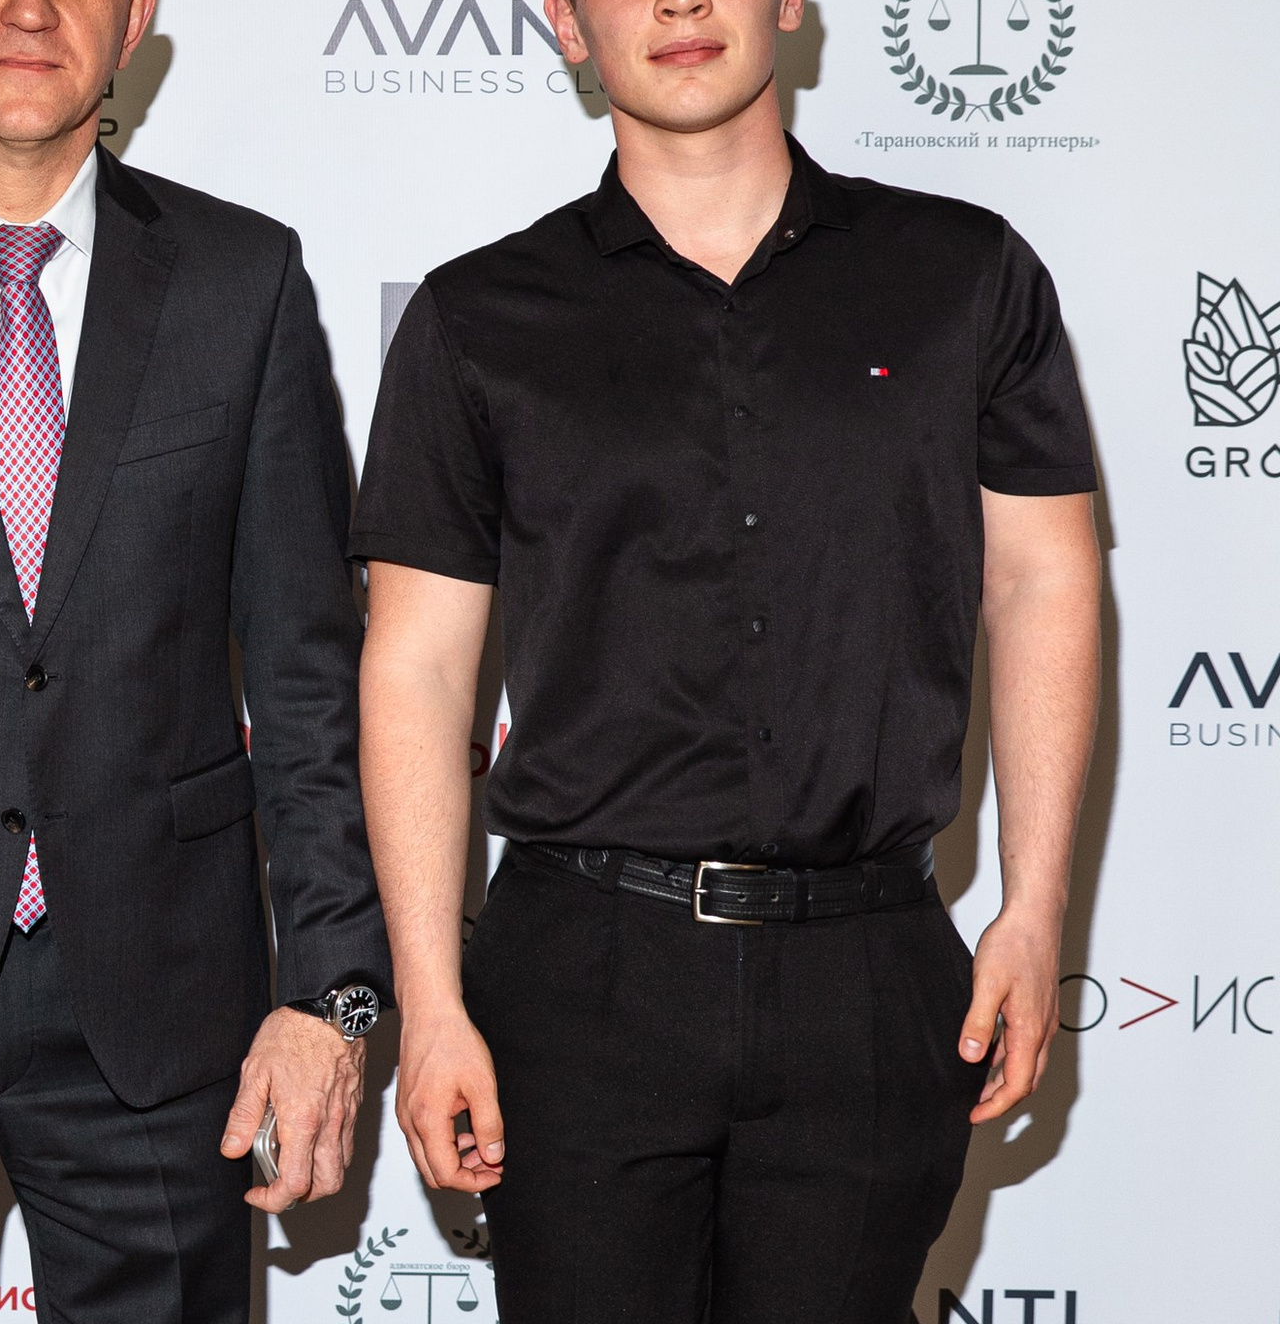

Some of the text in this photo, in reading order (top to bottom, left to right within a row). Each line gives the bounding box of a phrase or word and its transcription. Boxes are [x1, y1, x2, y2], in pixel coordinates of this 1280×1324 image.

[325, 69, 606, 94] BUSINESS CL
[854, 131, 1101, 153] «Тарановский и партнеры»
[1185, 443, 1280, 478] GRO
[1170, 722, 1280, 747] BUSIN
